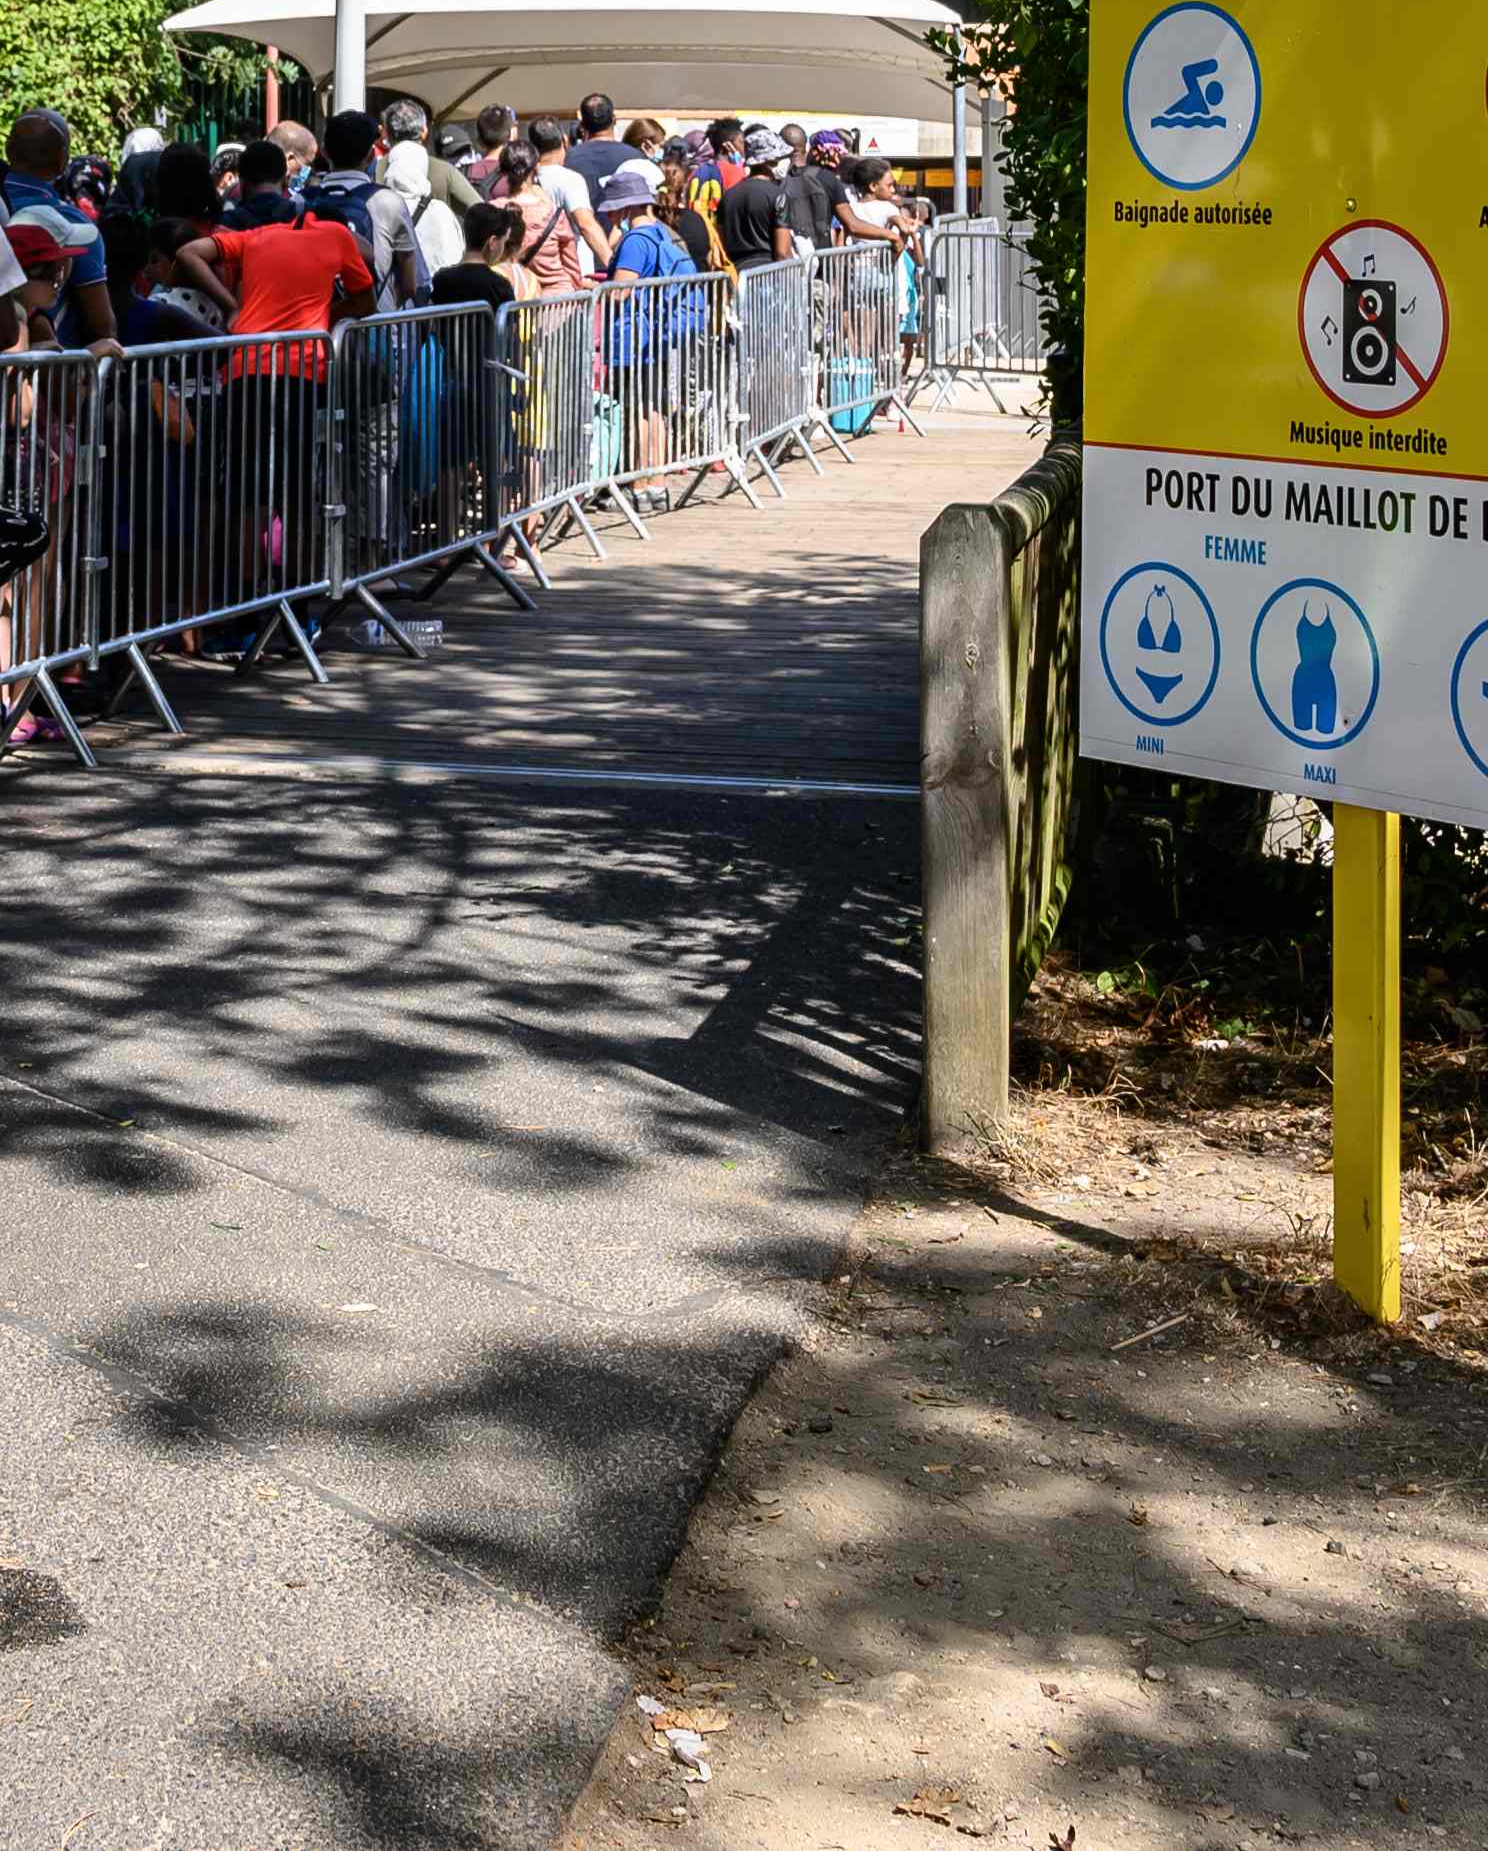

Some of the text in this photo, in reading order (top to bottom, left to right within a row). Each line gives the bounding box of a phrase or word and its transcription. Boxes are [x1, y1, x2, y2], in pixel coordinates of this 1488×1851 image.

[1114, 200, 1272, 228] Baignade autorisée
[1290, 421, 1447, 455] Musique interdite
[1145, 468, 1219, 514] PORT
[1230, 474, 1273, 518] DU
[1284, 485, 1415, 534] MAILLOT
[1429, 495, 1472, 538] DE
[1204, 535, 1267, 566] FEMME
[1136, 734, 1165, 756] MINI
[1304, 762, 1336, 786] MAXI
